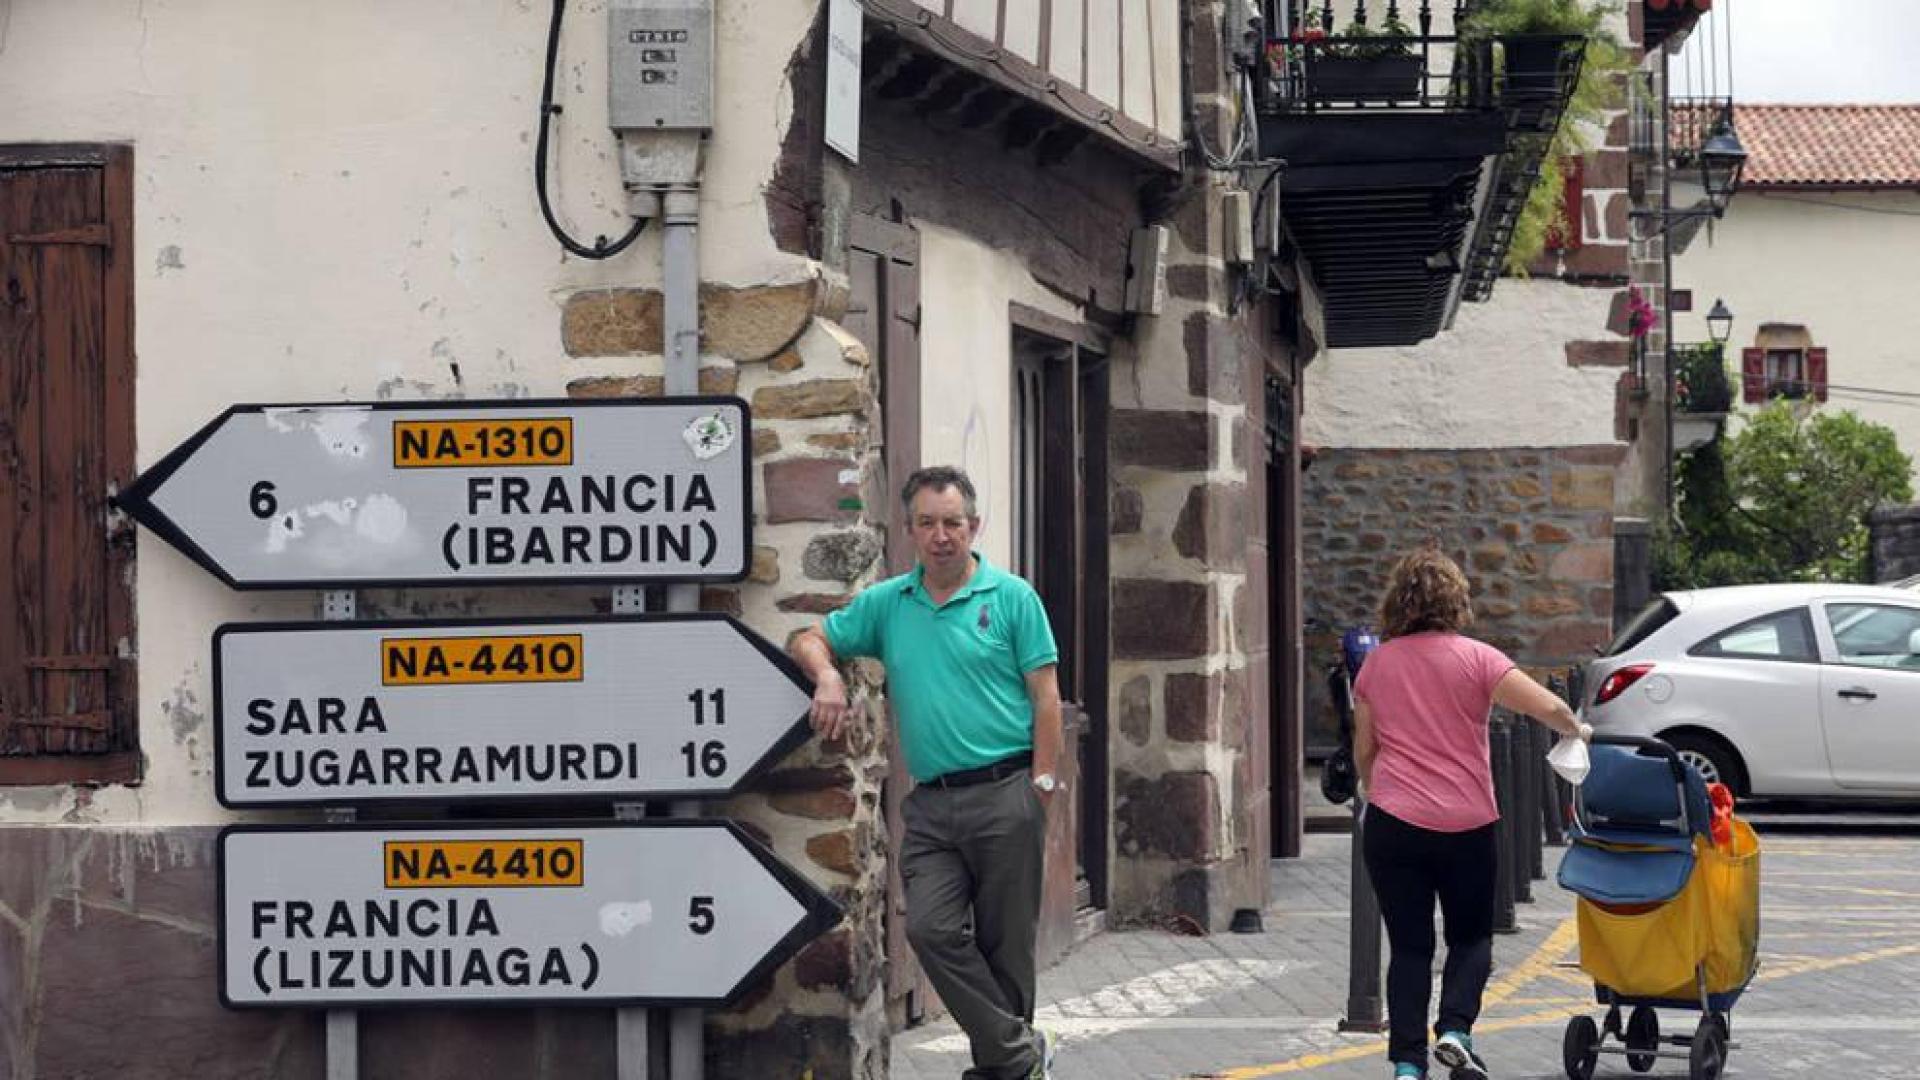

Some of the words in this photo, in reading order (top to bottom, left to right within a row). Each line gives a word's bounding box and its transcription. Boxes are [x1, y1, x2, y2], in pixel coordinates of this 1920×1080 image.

[400, 425, 565, 461] NA-1310
[249, 480, 278, 519] 6
[468, 474, 716, 515] FRANCIA
[443, 519, 717, 571] (IBARDIN)
[387, 641, 577, 679] NA-4410
[245, 696, 387, 736] SARA
[688, 687, 725, 726] 11
[245, 742, 637, 788] ZUGARRAMURDI
[680, 740, 727, 778] 16
[391, 846, 575, 881] NA-4410
[251, 898, 500, 940] FRANCIA
[689, 896, 715, 935] 5
[253, 942, 599, 995] (LIZUNIAGA)
